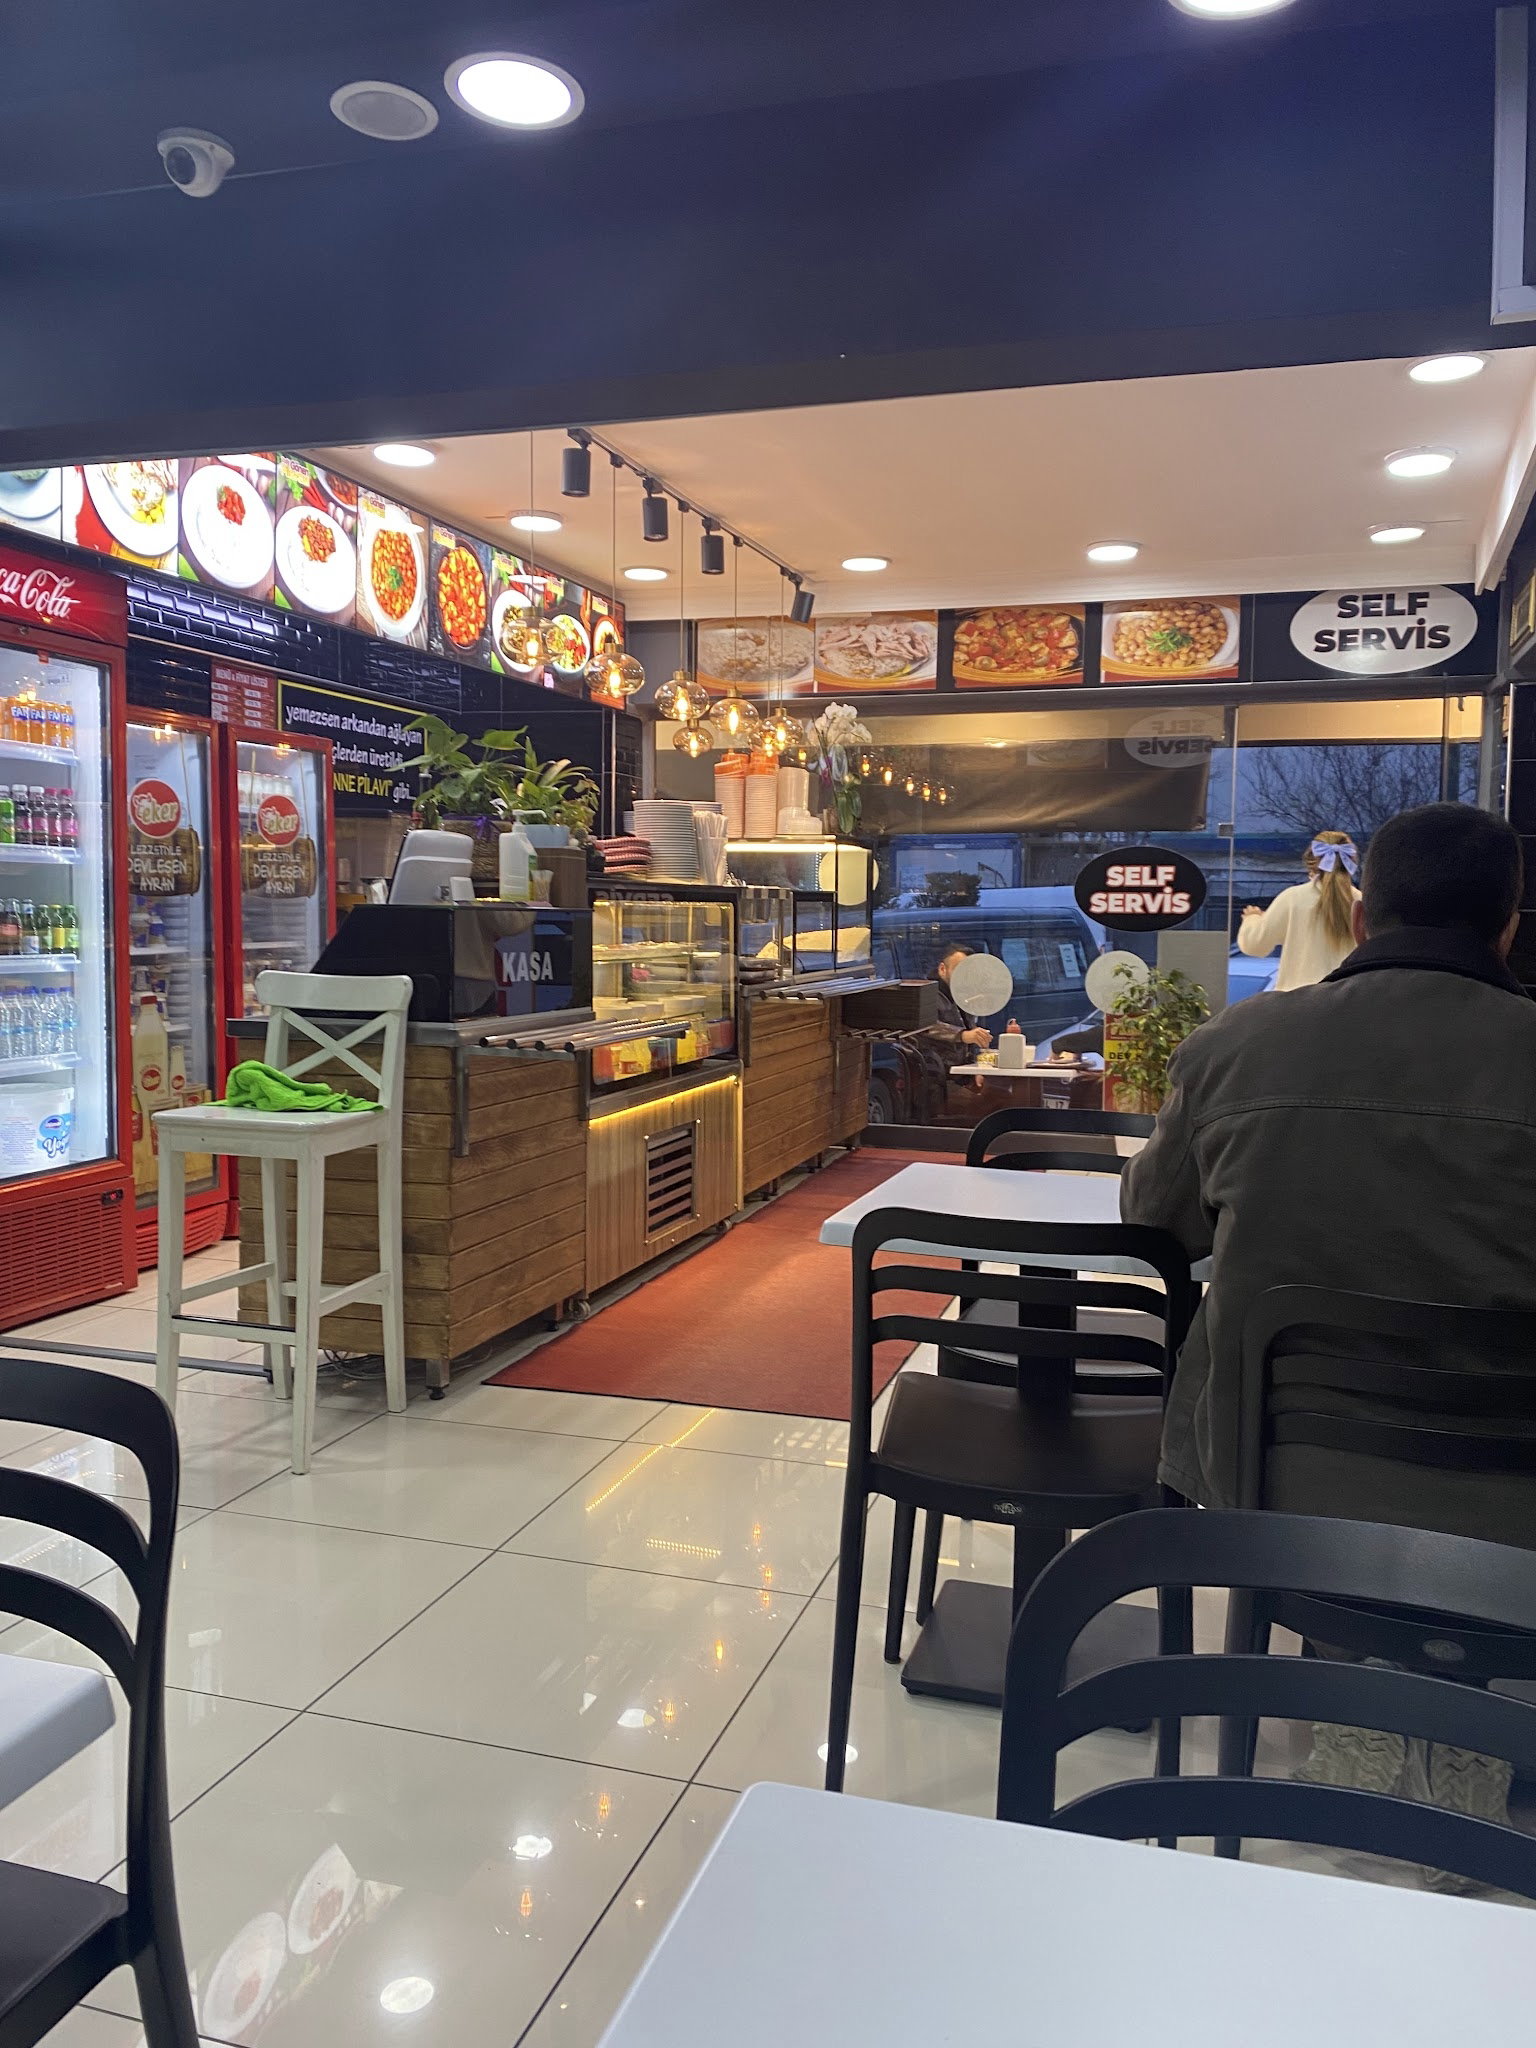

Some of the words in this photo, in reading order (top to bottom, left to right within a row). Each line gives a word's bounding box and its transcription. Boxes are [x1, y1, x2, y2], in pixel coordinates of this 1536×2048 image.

[1337, 592, 1430, 618] SELF
[1314, 617, 1450, 653] SERVİS
[285, 704, 341, 729] yemezsen
[341, 713, 387, 738] arkandan
[387, 722, 422, 747] ağlayan
[141, 798, 179, 823] eker
[263, 812, 298, 834] eker
[140, 877, 176, 892] AYRAN
[1106, 865, 1176, 887] SELF
[1089, 886, 1192, 915] SERVİS
[502, 951, 553, 982] KASA
